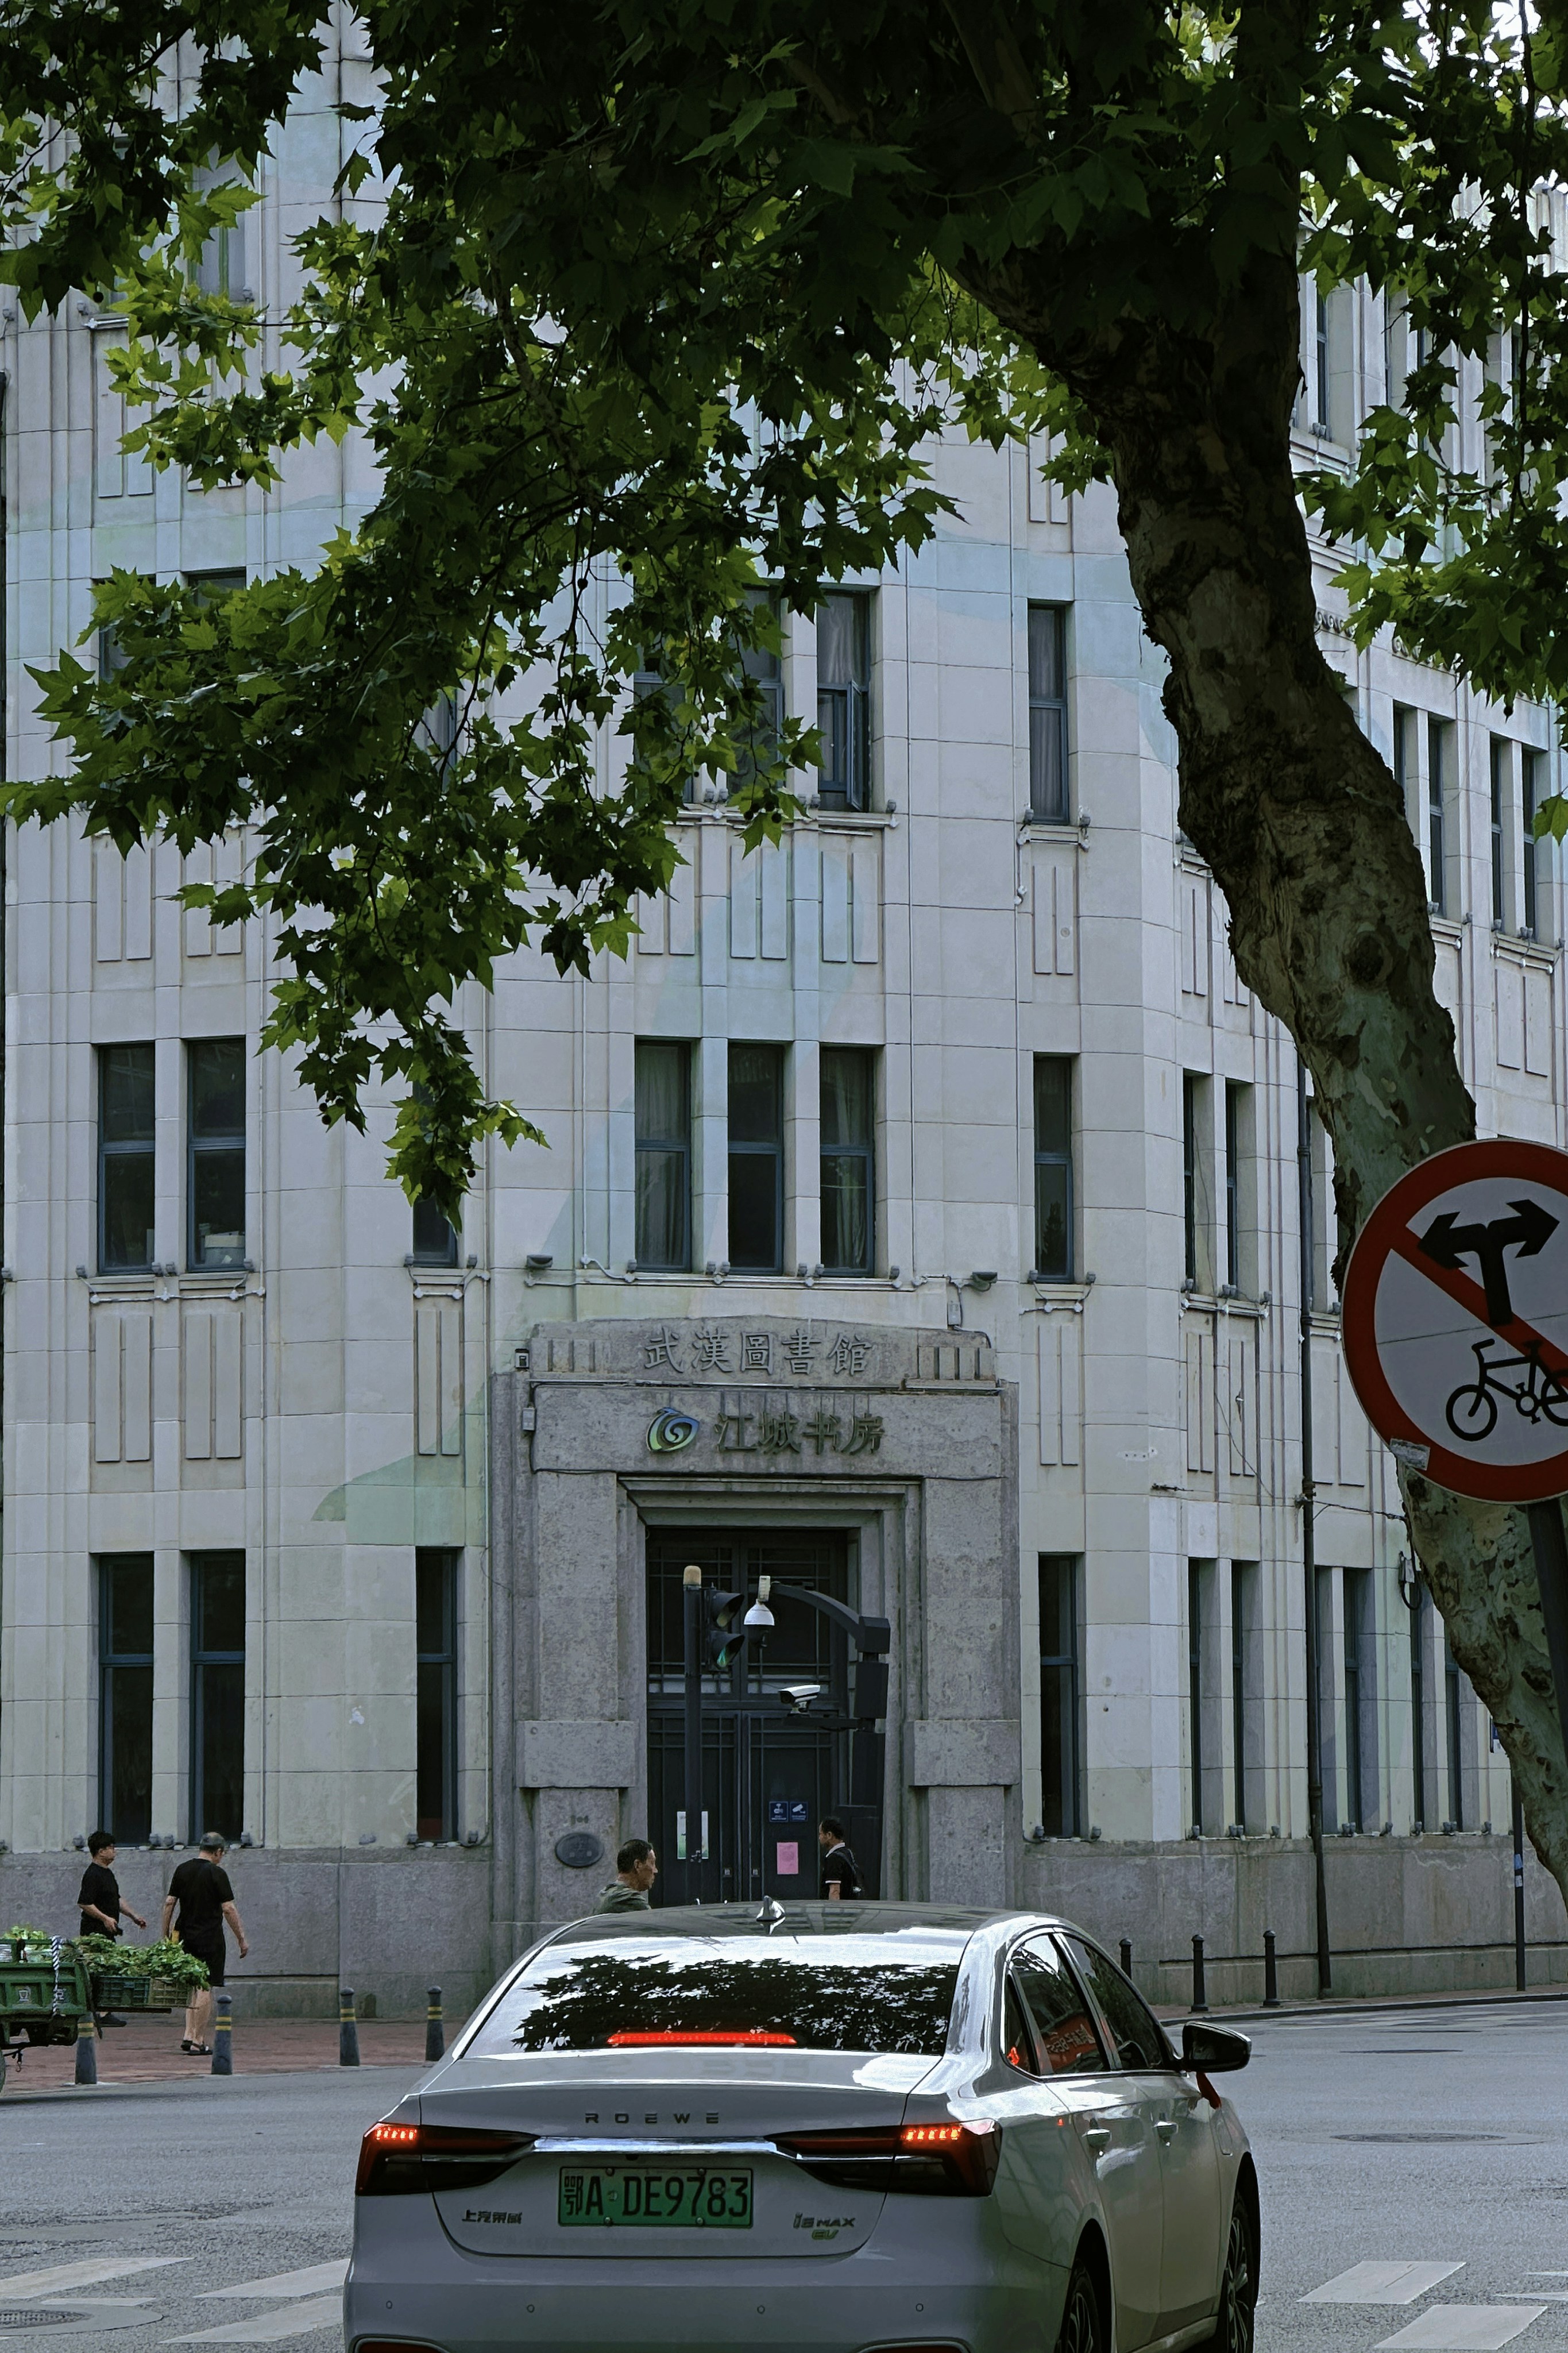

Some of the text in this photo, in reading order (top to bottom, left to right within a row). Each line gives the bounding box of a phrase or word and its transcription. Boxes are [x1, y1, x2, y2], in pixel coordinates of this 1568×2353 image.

[644, 1325, 873, 1376] 武漢圖書館
[713, 1411, 885, 1455] 江城书房
[585, 2112, 720, 2124] ROEWE
